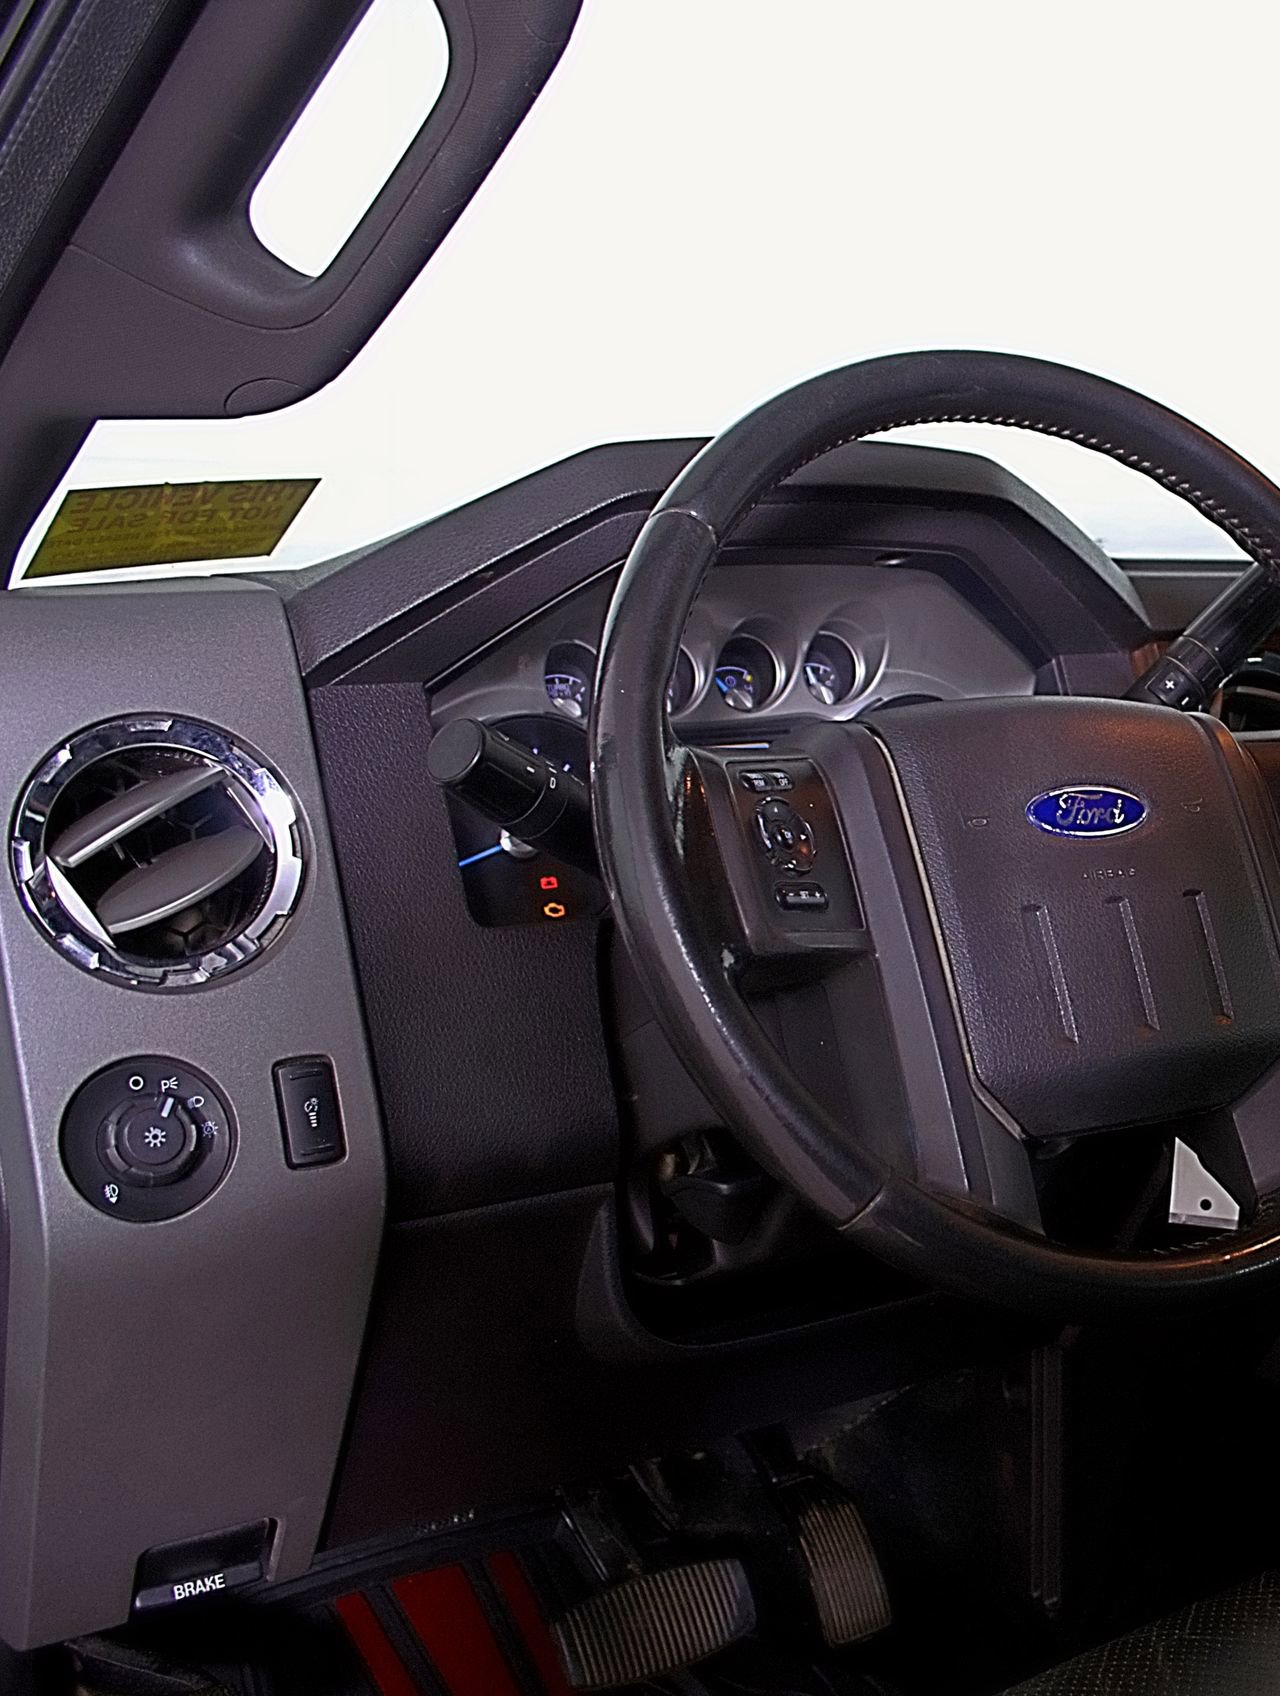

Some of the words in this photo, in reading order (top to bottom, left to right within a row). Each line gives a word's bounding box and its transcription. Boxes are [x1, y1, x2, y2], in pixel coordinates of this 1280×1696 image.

[1056, 793, 1124, 826] Ford
[1081, 868, 1136, 881] AIRBAG
[173, 1573, 225, 1600] BRAKE
